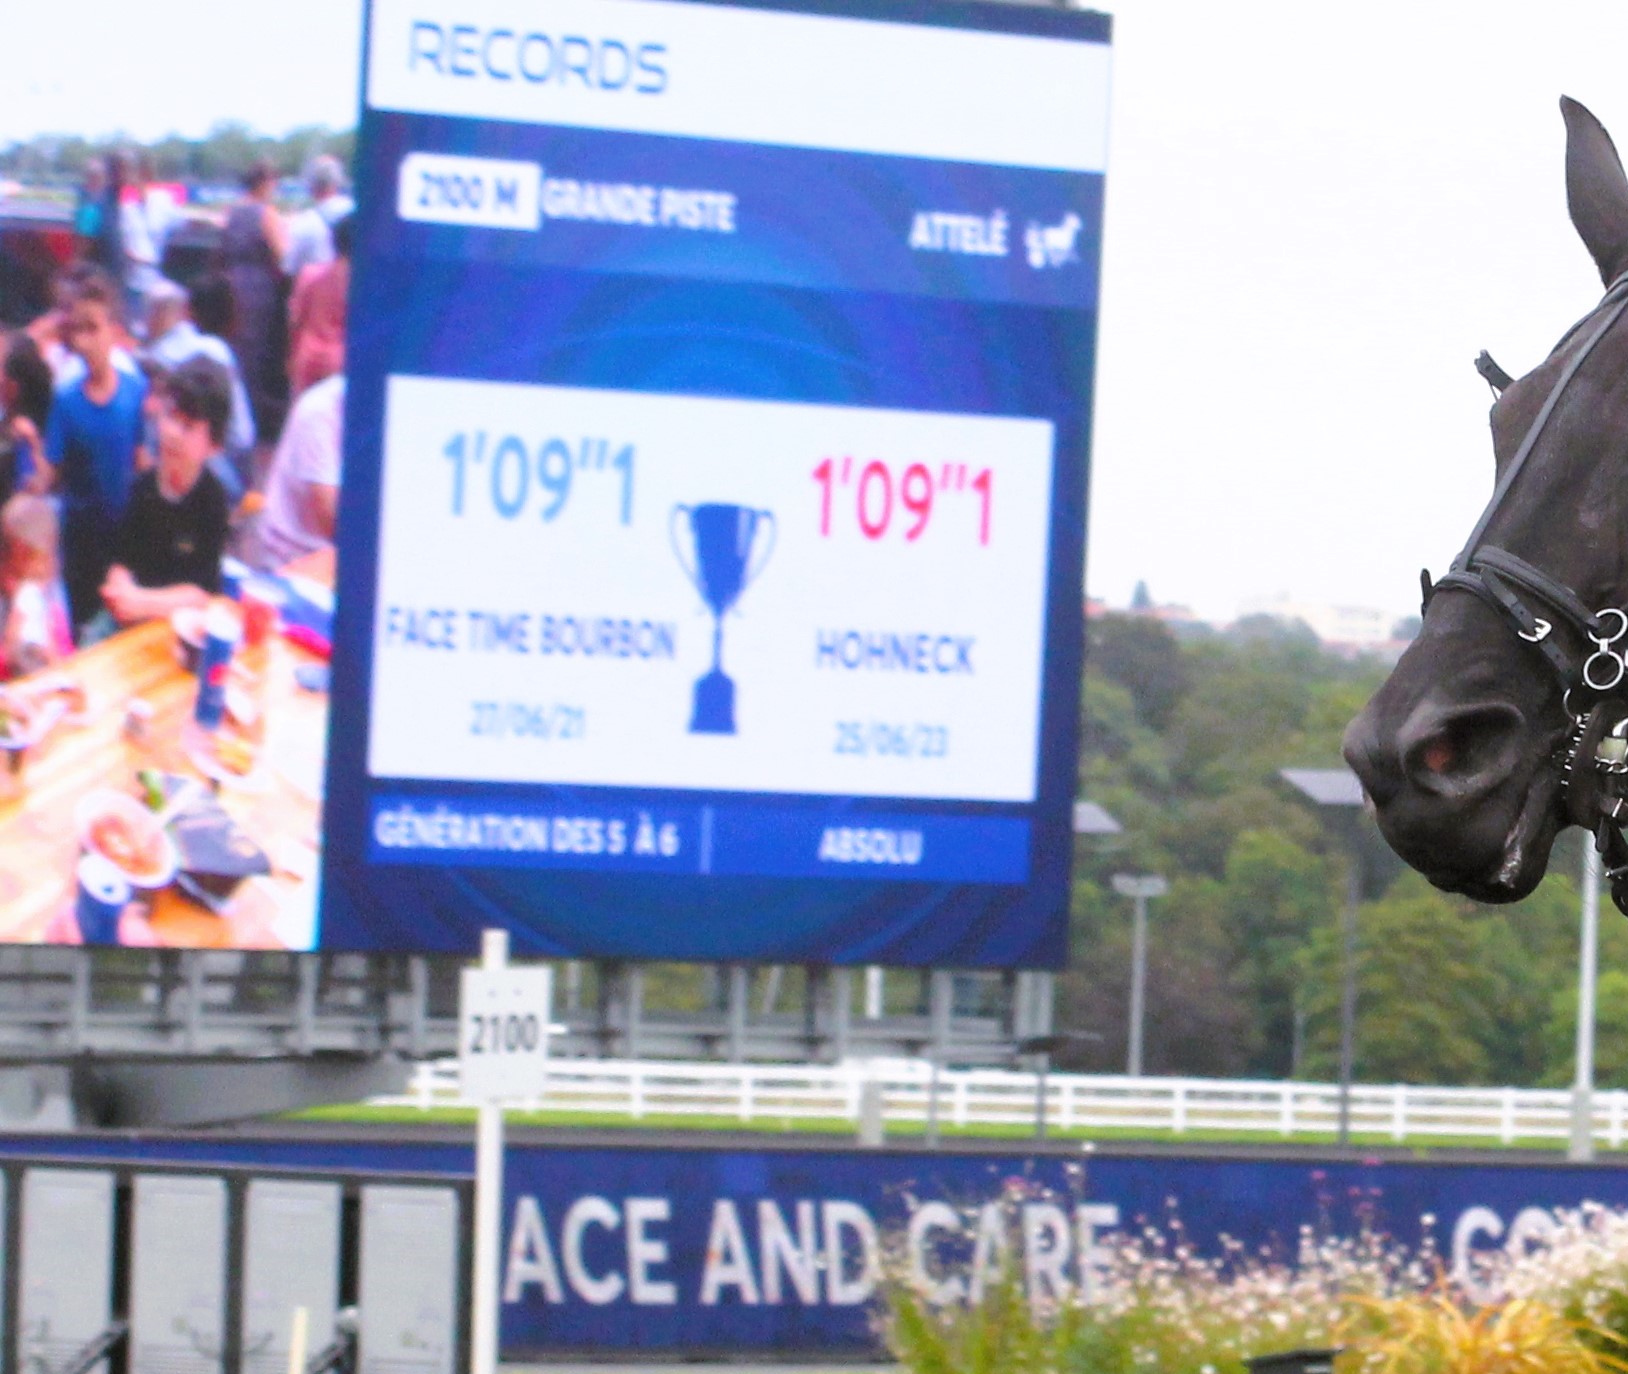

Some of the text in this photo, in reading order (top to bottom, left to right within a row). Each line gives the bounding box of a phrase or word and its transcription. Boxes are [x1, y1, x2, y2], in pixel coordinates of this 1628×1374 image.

[409, 21, 668, 95] RECORDS
[418, 171, 737, 232] 2100 M GRANDE PISTE
[909, 209, 1009, 257] ATTELÉ
[388, 606, 677, 661] FACE TIME BOURBON
[816, 630, 977, 676] HOHNECK
[469, 699, 585, 740] 27/06/21
[833, 720, 948, 758] 25/06/23
[375, 804, 679, 857] GÉNÉRATION DES 5 À 6
[818, 827, 924, 866] ABSOLU
[471, 1014, 540, 1053] 2100
[700, 1198, 883, 1305] AND
